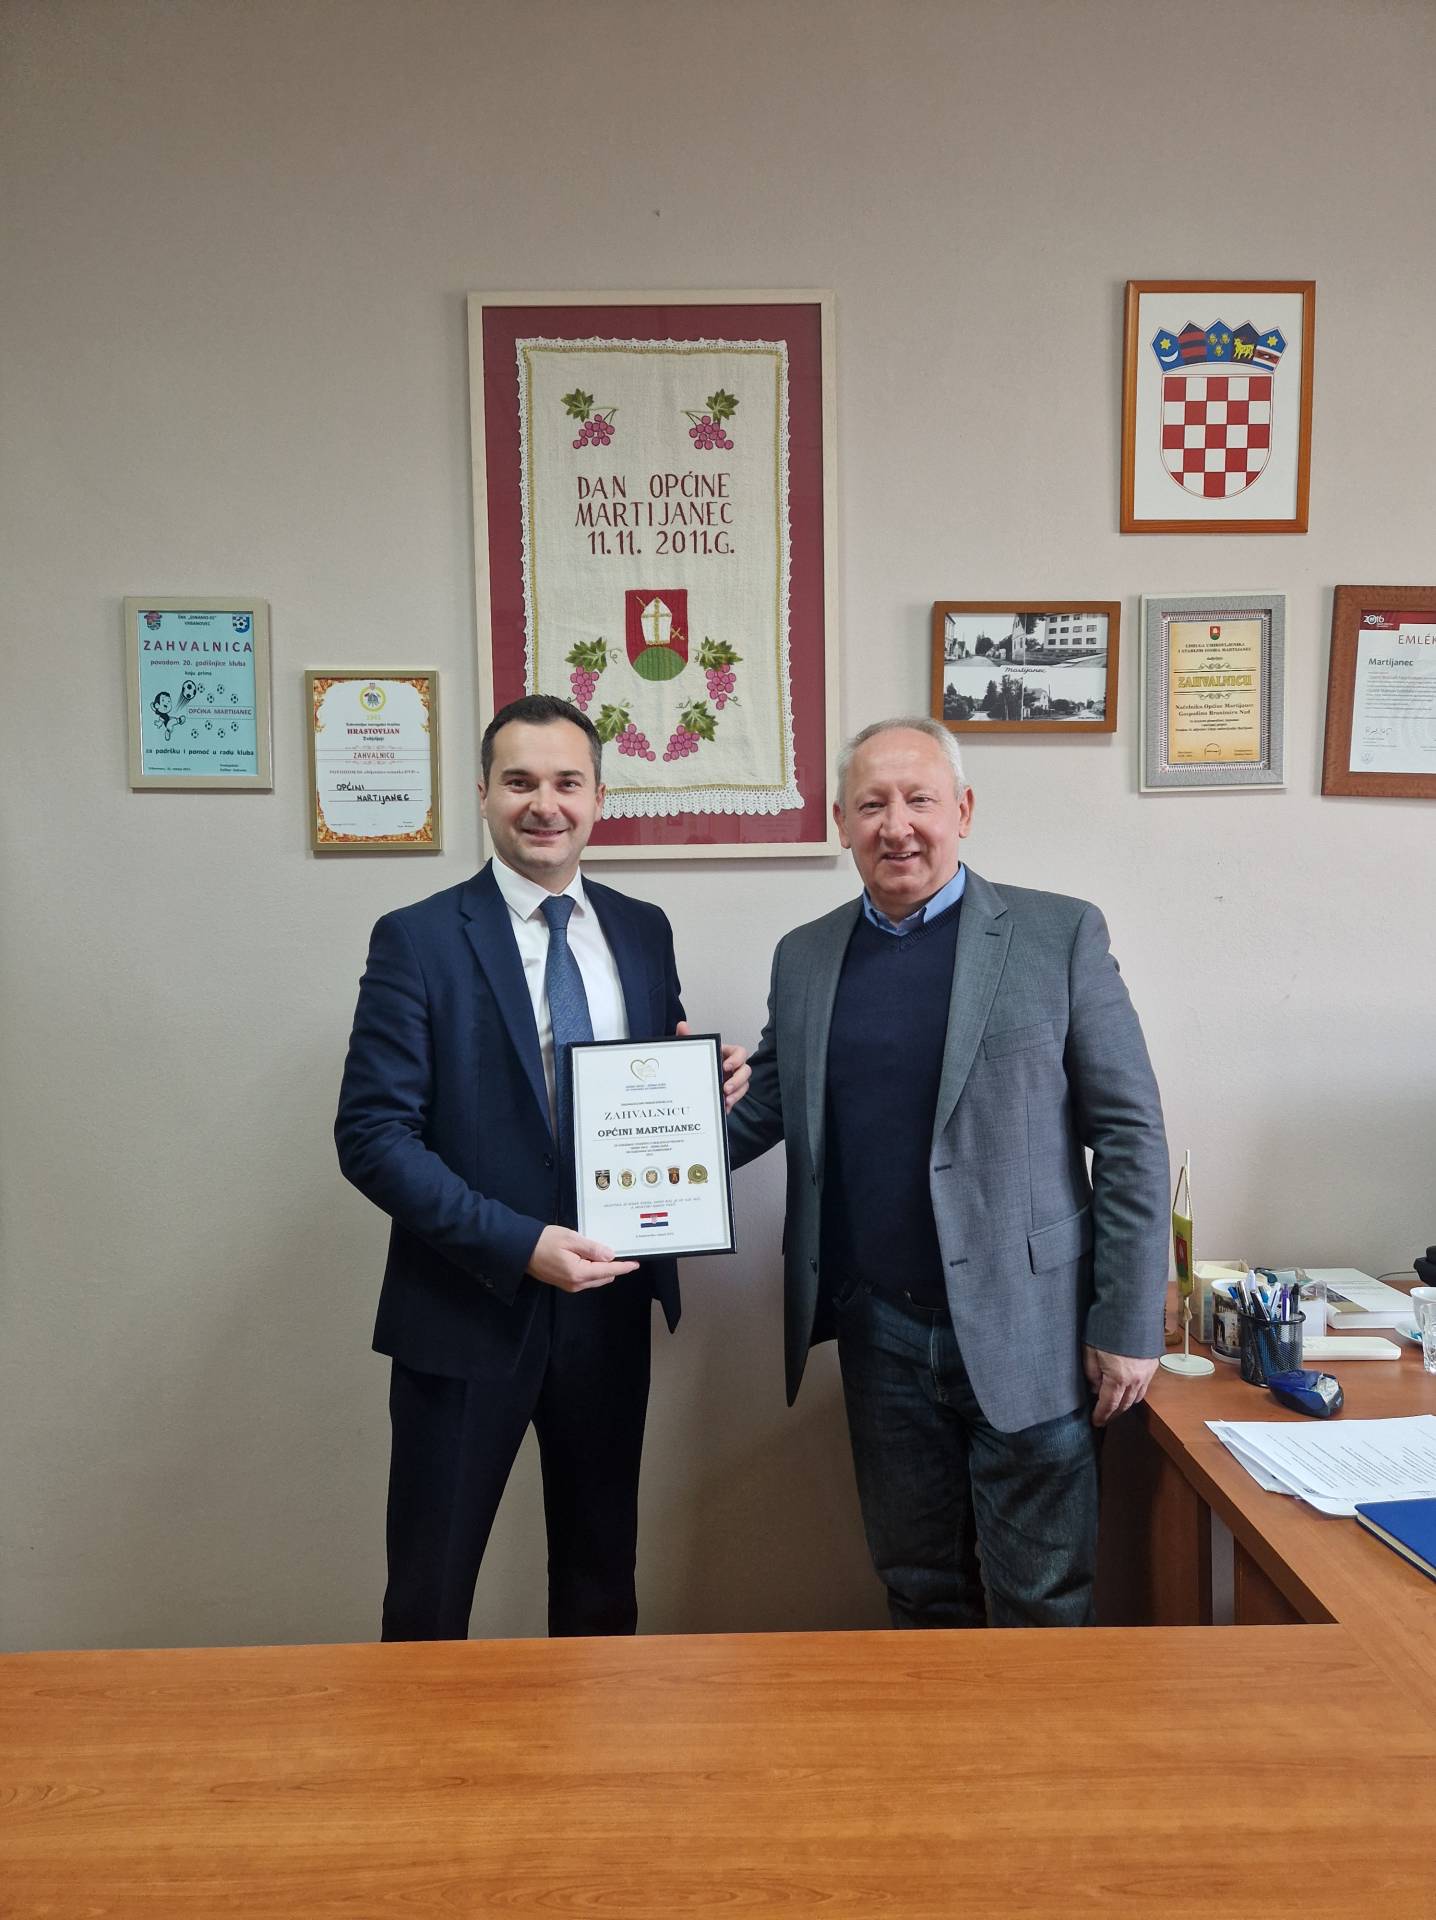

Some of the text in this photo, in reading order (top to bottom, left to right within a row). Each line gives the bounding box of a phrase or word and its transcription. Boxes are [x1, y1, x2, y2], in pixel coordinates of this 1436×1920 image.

[576, 471, 731, 499] DAN OPĆINE
[574, 501, 734, 527] MARTIJANEC
[655, 530, 735, 555] 2011.G.
[143, 640, 252, 653] ZAHVALNICA
[1368, 658, 1414, 668] Martijanec
[1178, 674, 1253, 689] ZAHVALNICU
[336, 781, 365, 791] OPĆINI
[597, 1123, 702, 1138] OPĆINI MARTIJANEC
